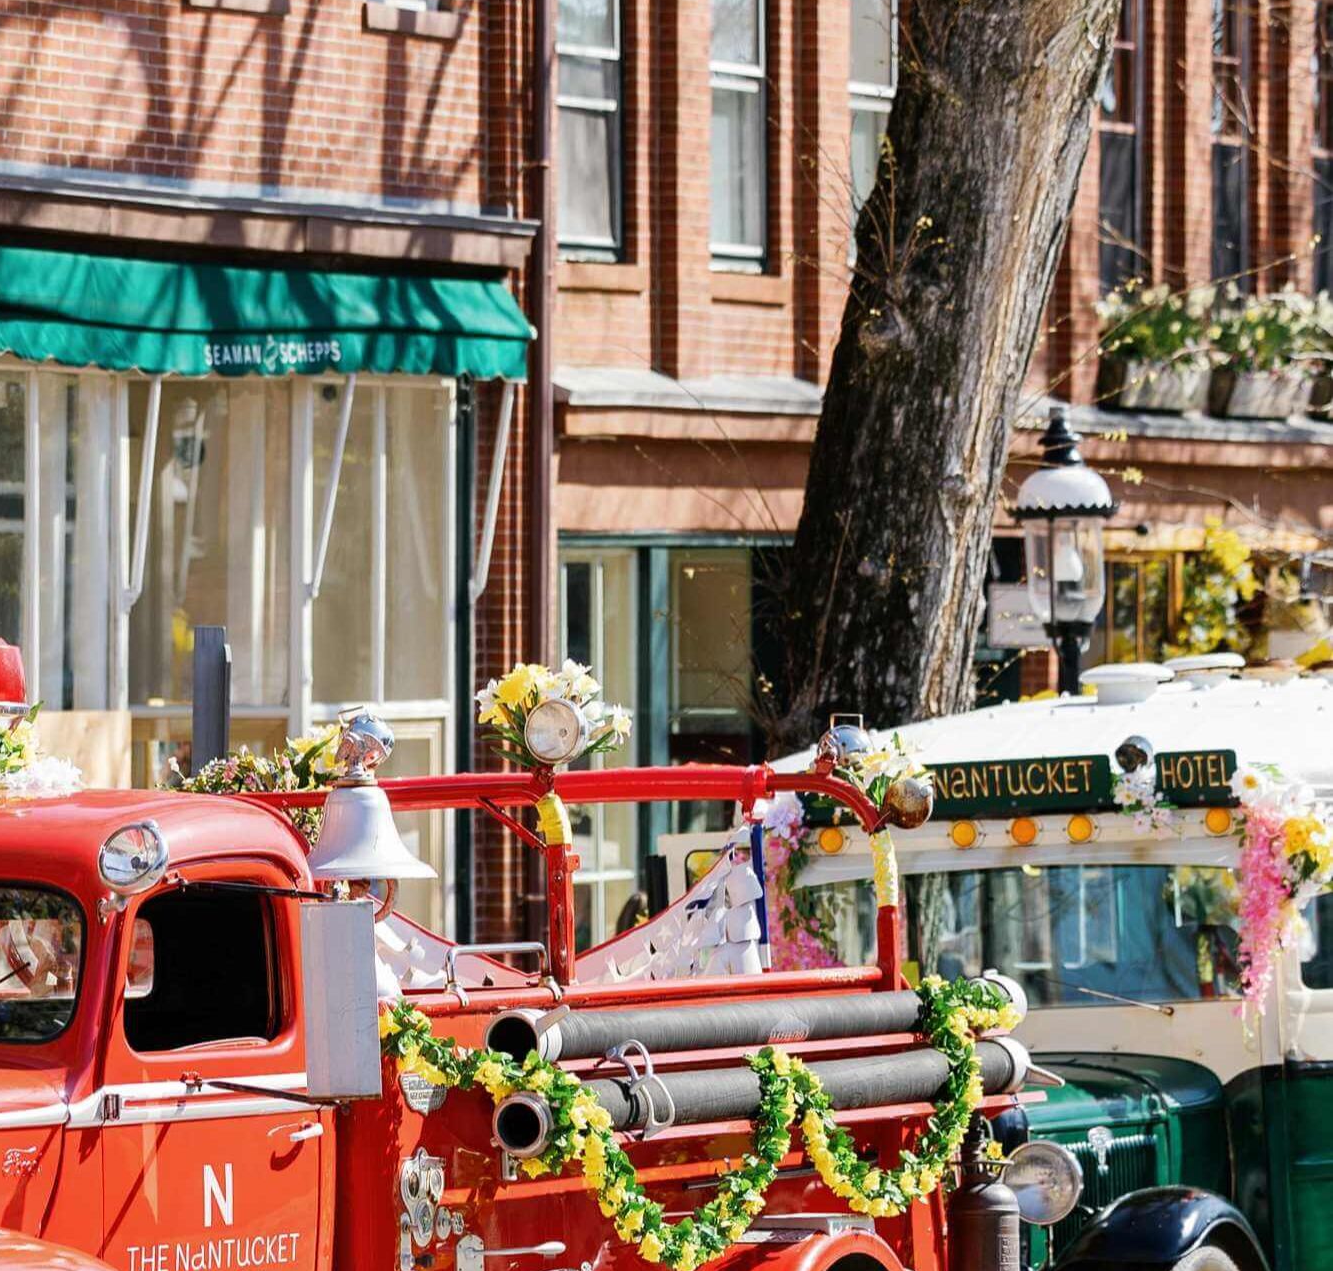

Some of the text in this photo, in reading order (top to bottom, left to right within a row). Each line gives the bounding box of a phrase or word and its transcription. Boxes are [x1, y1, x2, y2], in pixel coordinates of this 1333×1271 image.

[204, 339, 342, 367] SEAMAN SCHEPPS
[1160, 753, 1232, 789] HOTEL
[203, 1162, 234, 1228] N
